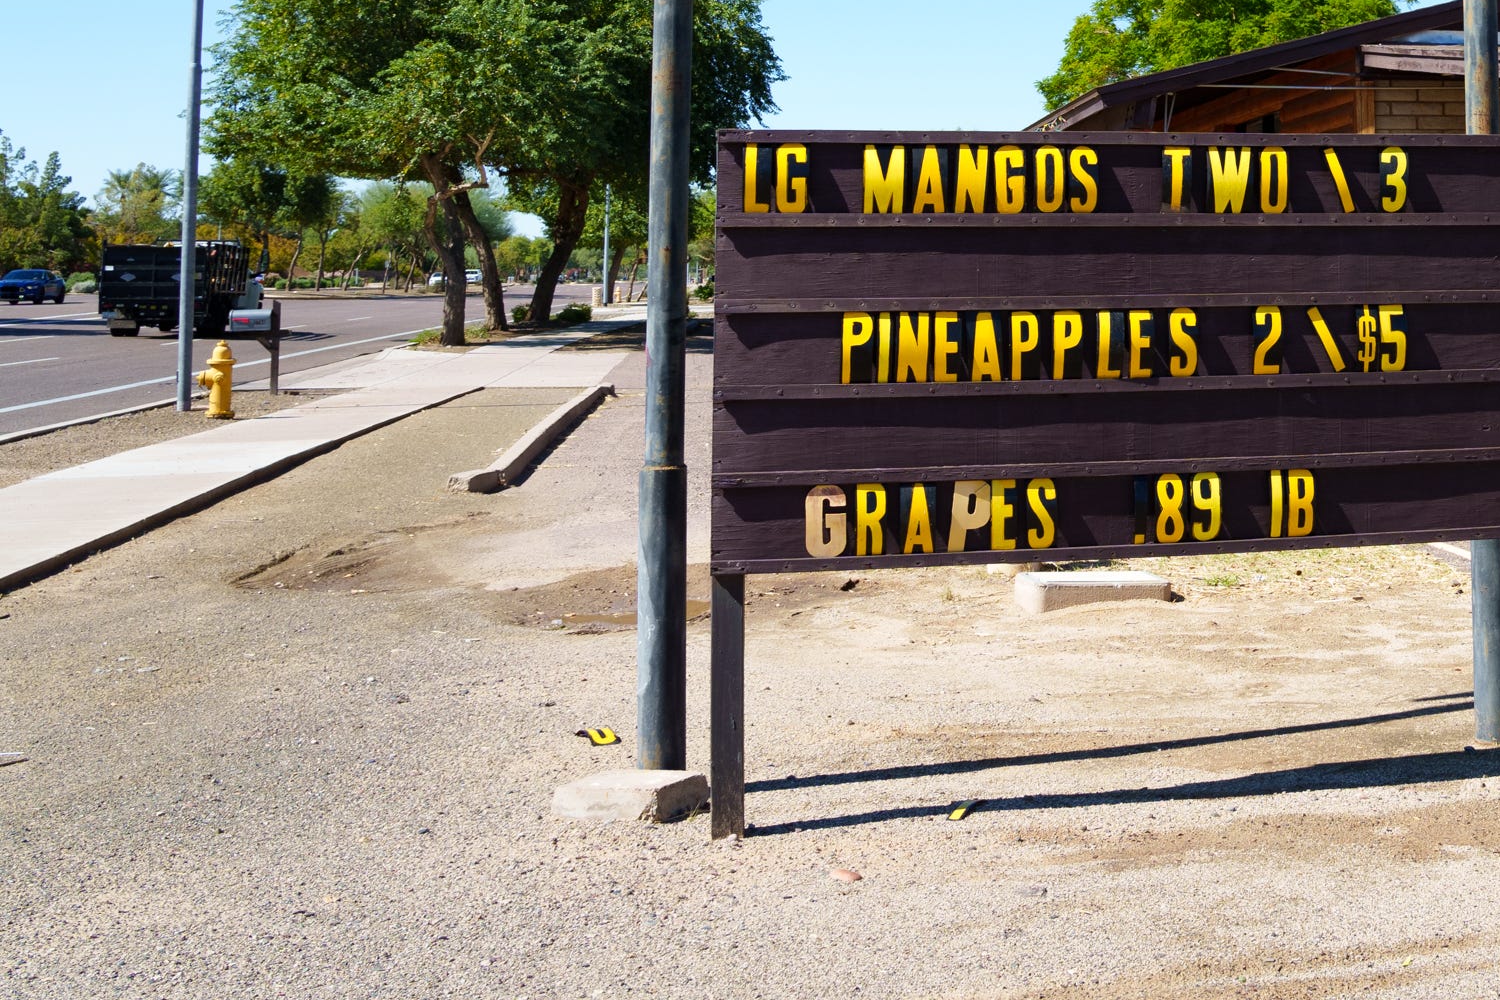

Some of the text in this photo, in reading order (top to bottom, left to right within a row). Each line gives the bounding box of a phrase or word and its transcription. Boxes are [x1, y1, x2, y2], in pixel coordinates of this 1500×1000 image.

[744, 143, 807, 213] LG
[863, 144, 1098, 214] MANGOS
[1164, 146, 1288, 214] TWO
[1381, 146, 1407, 213] 3
[841, 307, 1198, 384] PINEAPPLES
[1253, 305, 1282, 375] 2
[805, 478, 1057, 558] GRAPES
[1134, 471, 1222, 544] .89
